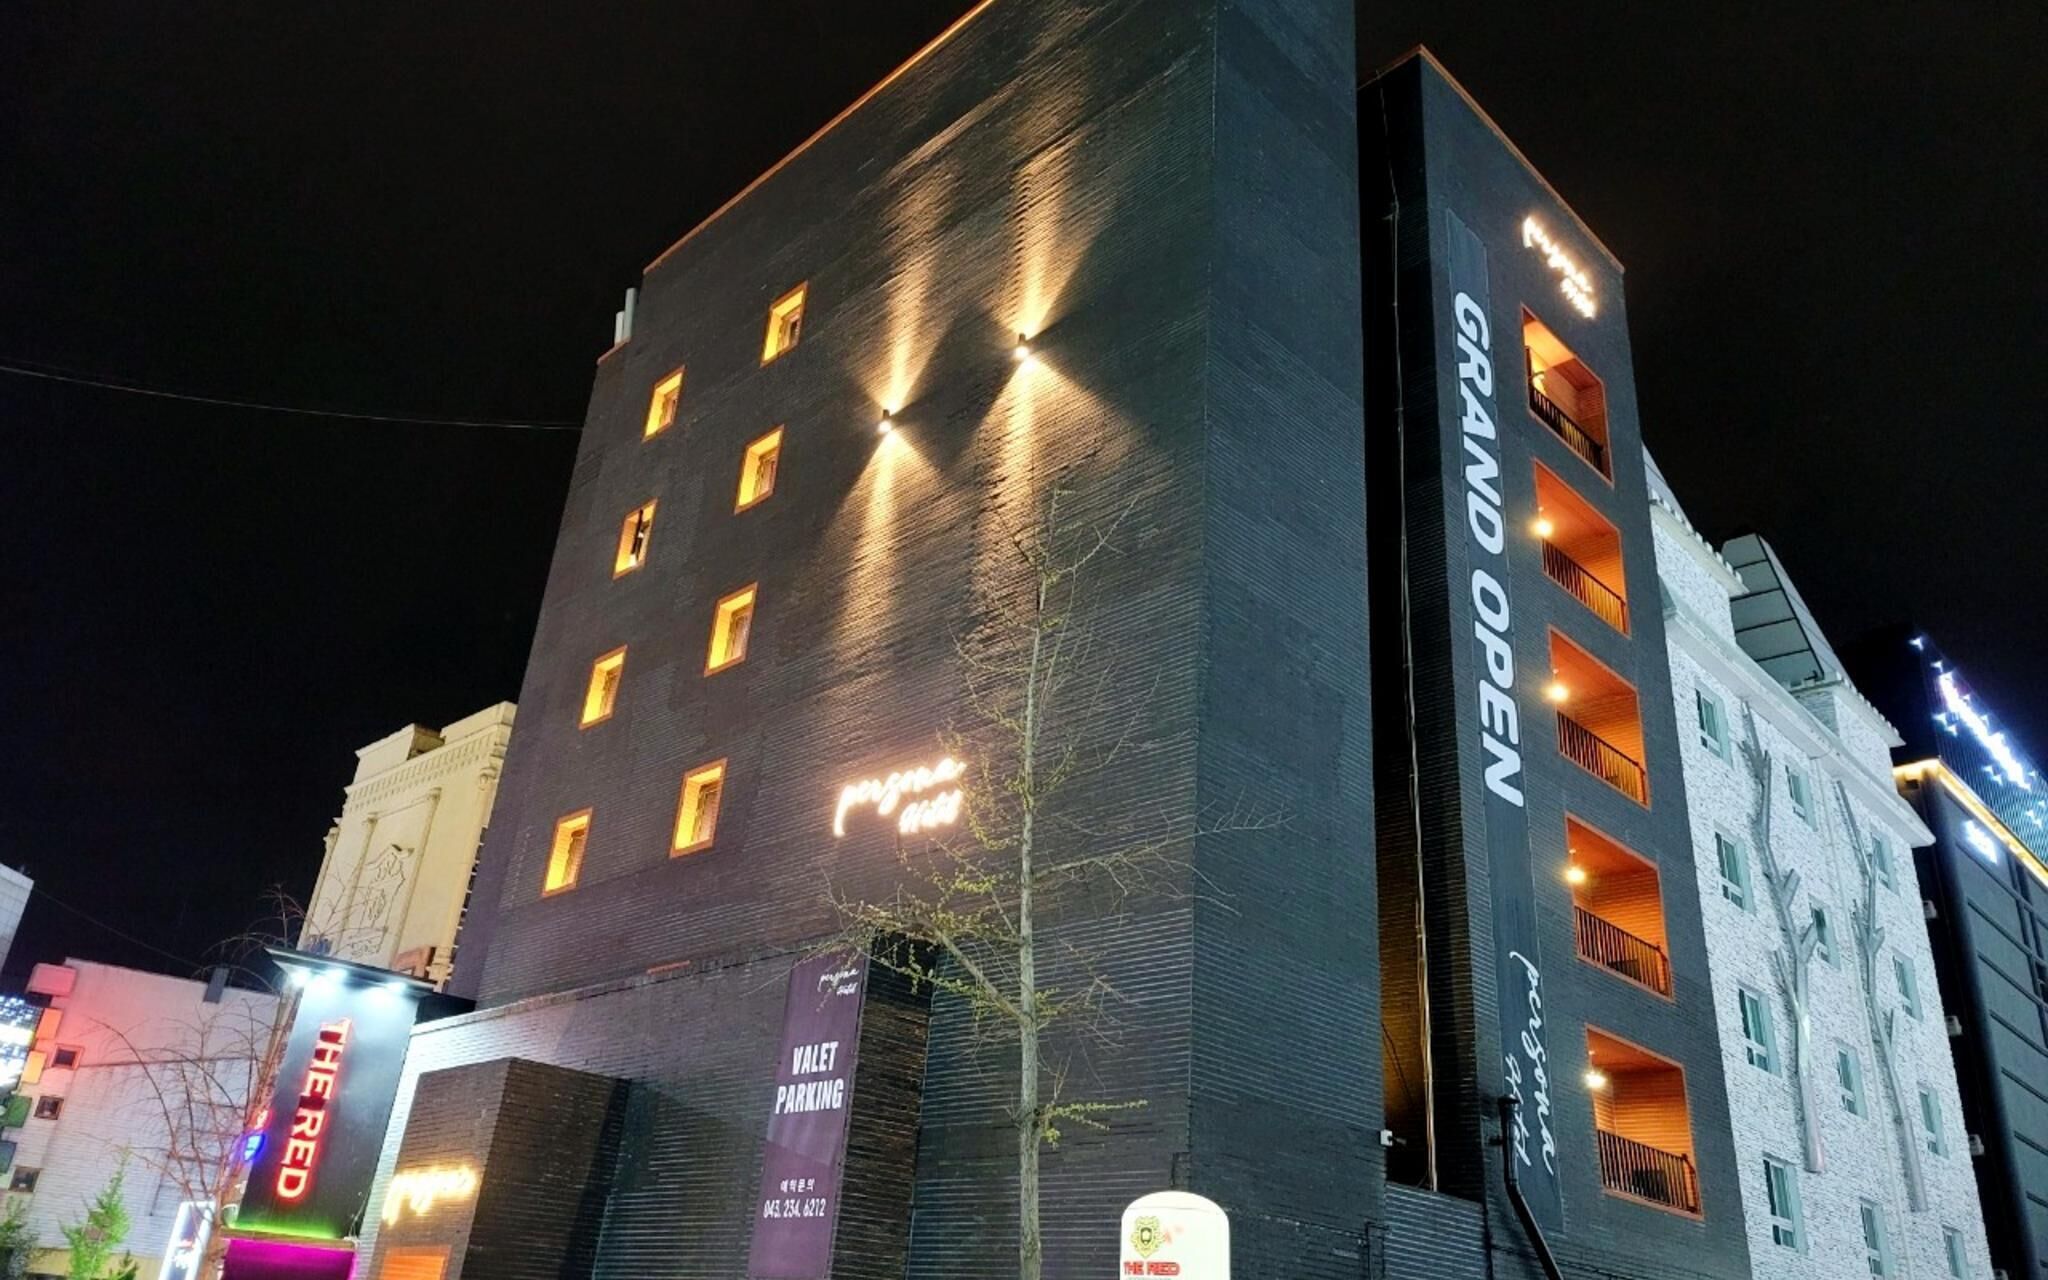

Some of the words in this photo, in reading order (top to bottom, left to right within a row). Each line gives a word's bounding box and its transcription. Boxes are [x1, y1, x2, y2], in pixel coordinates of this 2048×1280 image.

[1454, 291, 1504, 555] GRAND
[1472, 569, 1524, 808] OPEN
[303, 1017, 353, 1101] THE
[775, 1079, 844, 1115] PARKING
[792, 1041, 839, 1075] VALET
[1508, 951, 1555, 1175] persona
[278, 1110, 326, 1199] RED
[1124, 1261, 1144, 1275] THE
[1147, 1261, 1180, 1275] RED
